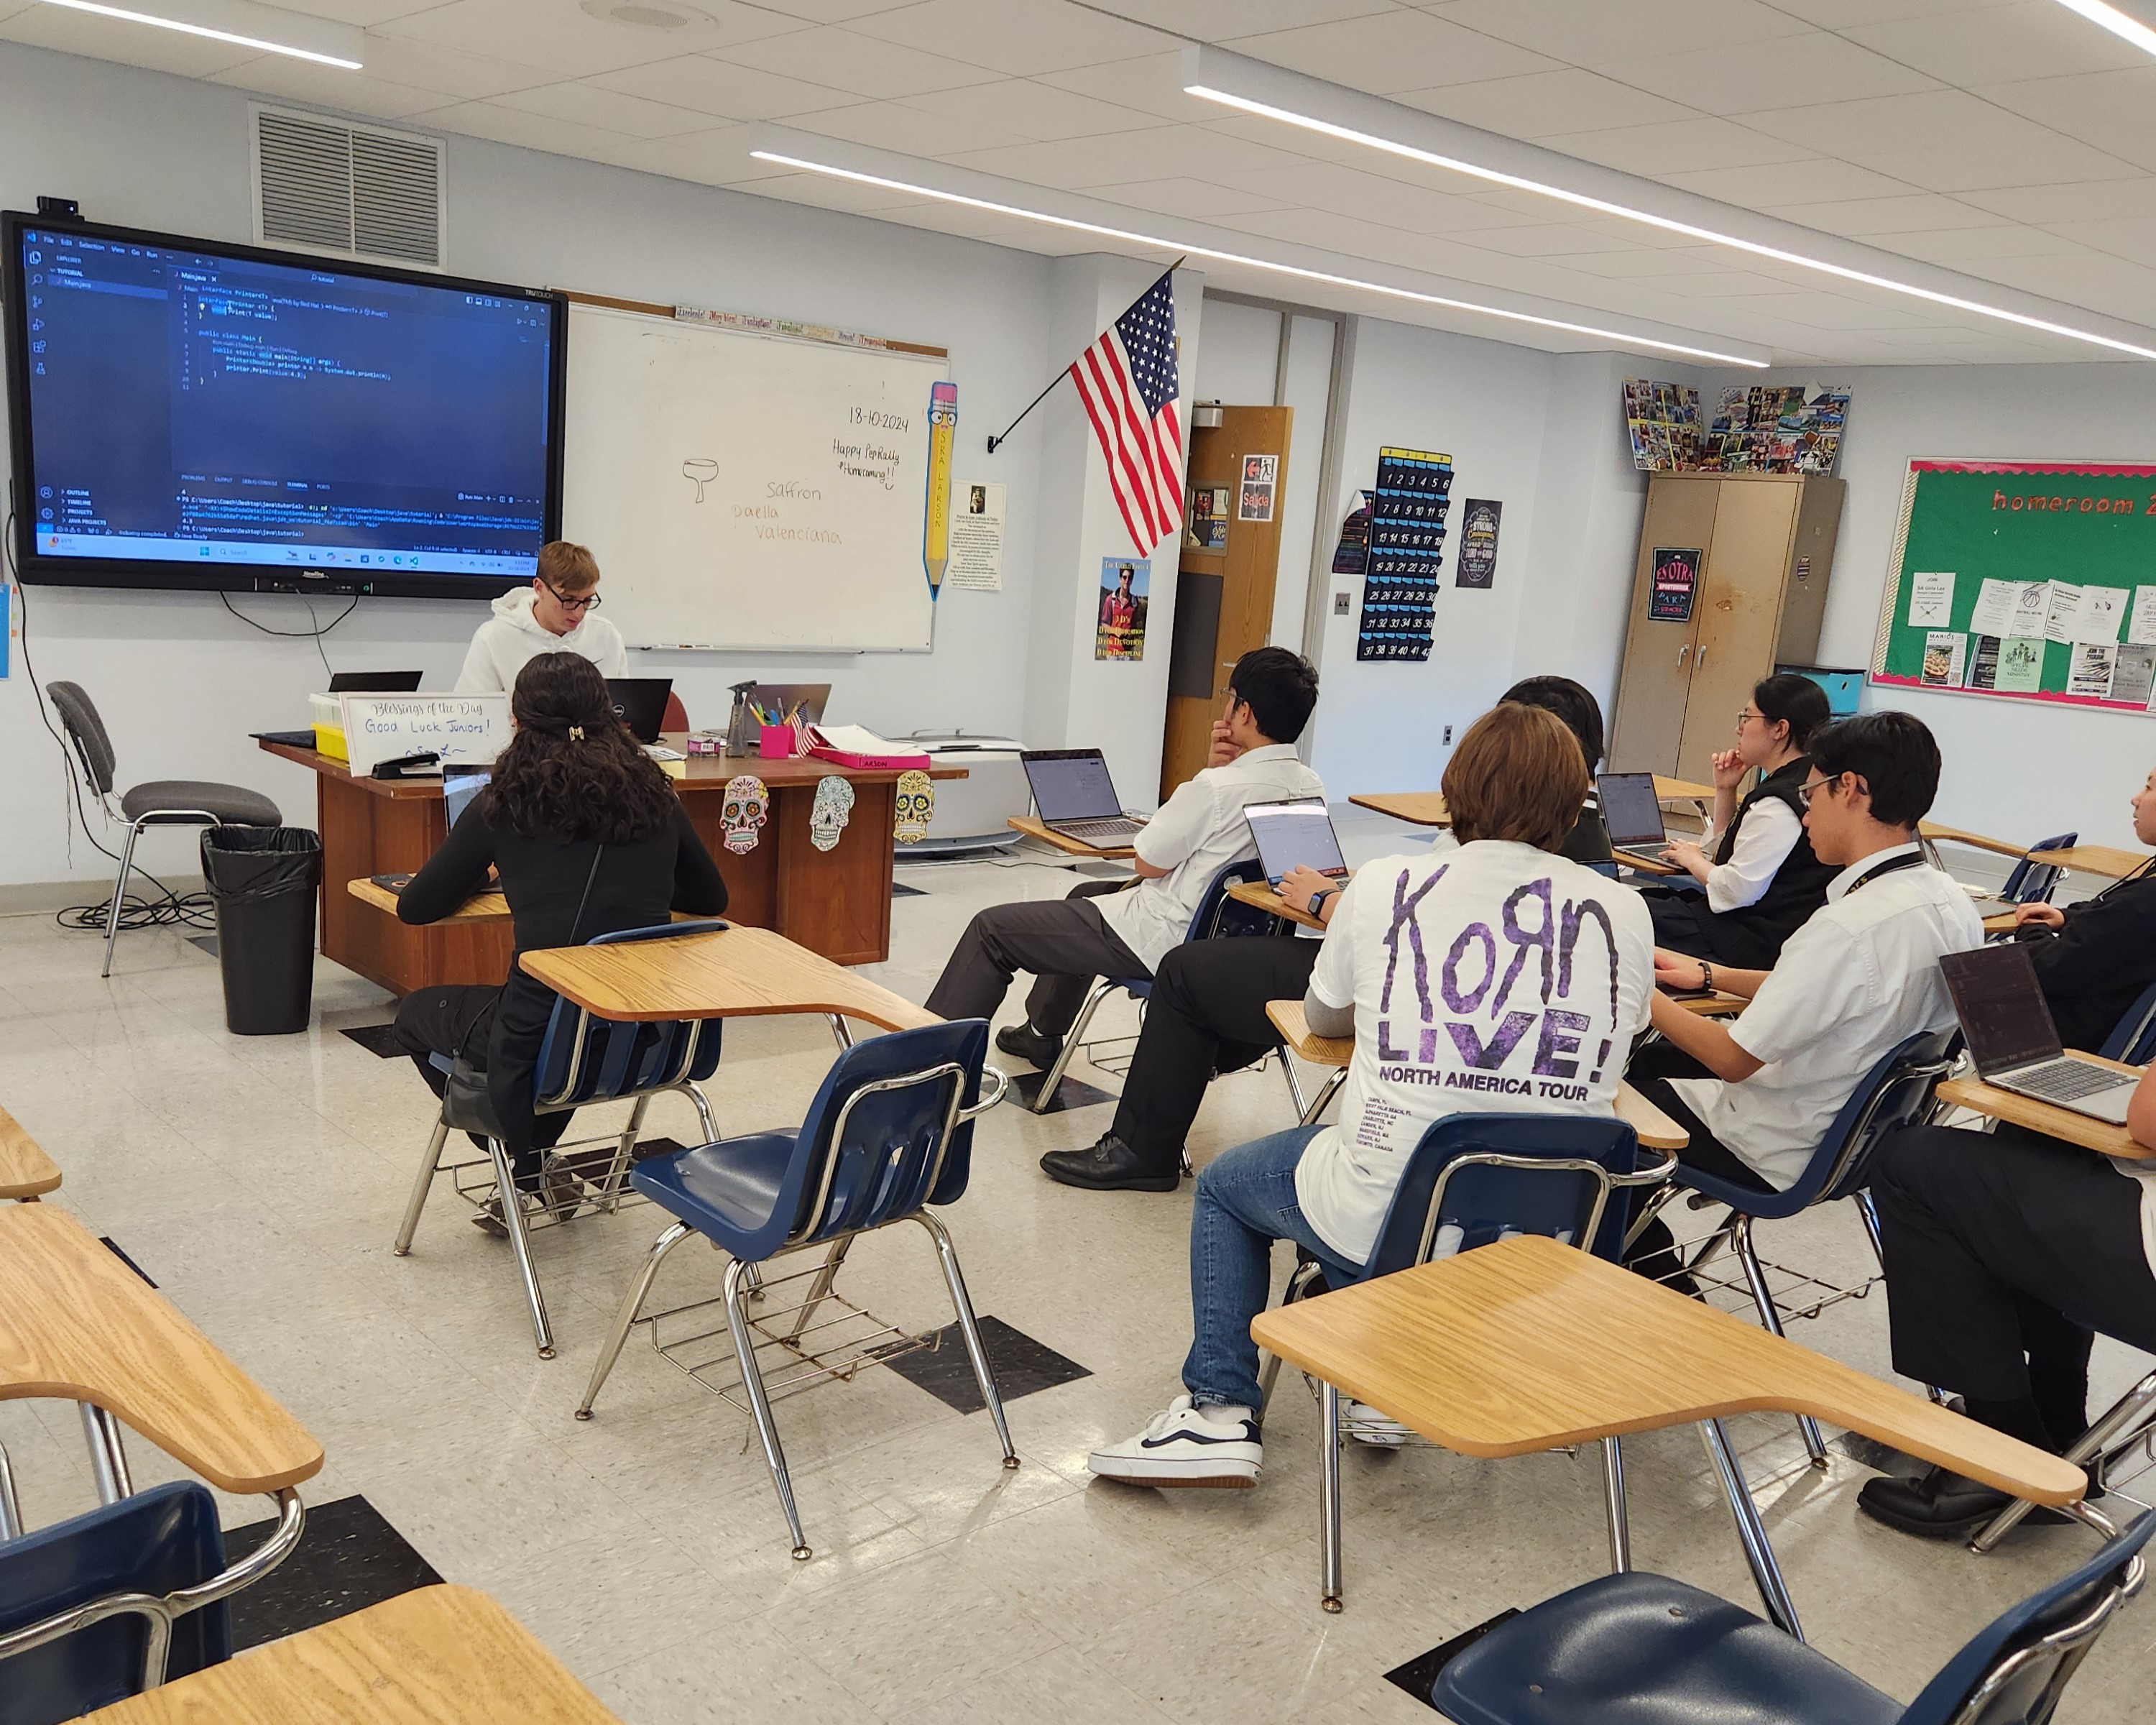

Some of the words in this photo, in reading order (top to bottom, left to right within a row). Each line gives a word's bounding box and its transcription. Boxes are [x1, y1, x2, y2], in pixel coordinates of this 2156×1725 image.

[79, 241, 105, 252] Selection
[57, 267, 84, 277] TUTORIAL
[850, 407, 908, 433] 18-10-2024
[833, 438, 861, 460] Happy
[1387, 474, 1393, 484] 1
[1396, 474, 1404, 484] 2
[1408, 476, 1415, 485] 3
[1420, 477, 1427, 487] 4
[1431, 478, 1439, 487] 5
[1442, 479, 1450, 489] 6
[767, 482, 821, 500] Saffron
[1243, 492, 1269, 507] Sada
[1991, 489, 2134, 515] homeroom
[1383, 504, 1389, 513] 7
[1393, 504, 1400, 514] 8
[1404, 505, 1412, 515] 9
[1415, 506, 1424, 516] 10
[1427, 507, 1435, 517] 11
[1437, 507, 1447, 518] 12
[755, 525, 842, 544] Valenciana
[1379, 533, 1387, 543] 13
[1389, 533, 1398, 543] 14
[1401, 533, 1410, 543] 15
[1412, 535, 1421, 544] 16
[1423, 535, 1433, 545] 17
[1434, 536, 1443, 546] 18
[1376, 561, 1383, 571] 19
[1384, 561, 1394, 571] 20
[1396, 562, 1406, 571] 21
[1407, 562, 1418, 572] 22
[1419, 563, 1429, 573] 23
[1657, 564, 1667, 579] ES
[1669, 561, 1693, 581] OTRA
[1369, 590, 1380, 600] 25
[1381, 590, 1391, 600] 26
[1392, 590, 1403, 600] 27
[1404, 591, 1415, 600] 28
[1414, 591, 1426, 600] 29
[1426, 592, 1437, 602] 30
[1659, 592, 1686, 603] PARA
[1366, 619, 1376, 628] 31
[1377, 618, 1388, 627] 32
[1389, 618, 1400, 627] 33
[1401, 617, 1411, 627] 34
[1413, 618, 1423, 627] 35
[1423, 619, 1434, 628] 36
[1364, 645, 1374, 656] 37
[1376, 645, 1386, 654] 38
[1388, 645, 1398, 655] 39
[1398, 645, 1409, 655] 40
[1411, 645, 1420, 655] 41
[371, 702, 424, 717] Blessings
[427, 702, 436, 715] of
[438, 702, 455, 714] the
[457, 702, 483, 715] Day
[366, 719, 398, 733] Good
[411, 720, 441, 733] Luck
[1378, 1008, 1613, 1083] LIVE!
[1379, 1067, 1440, 1086] NORTH
[1445, 1072, 1531, 1095] AMERICA
[1539, 1082, 1589, 1102] TOUR
[1375, 1144, 1393, 1152] CANADA
